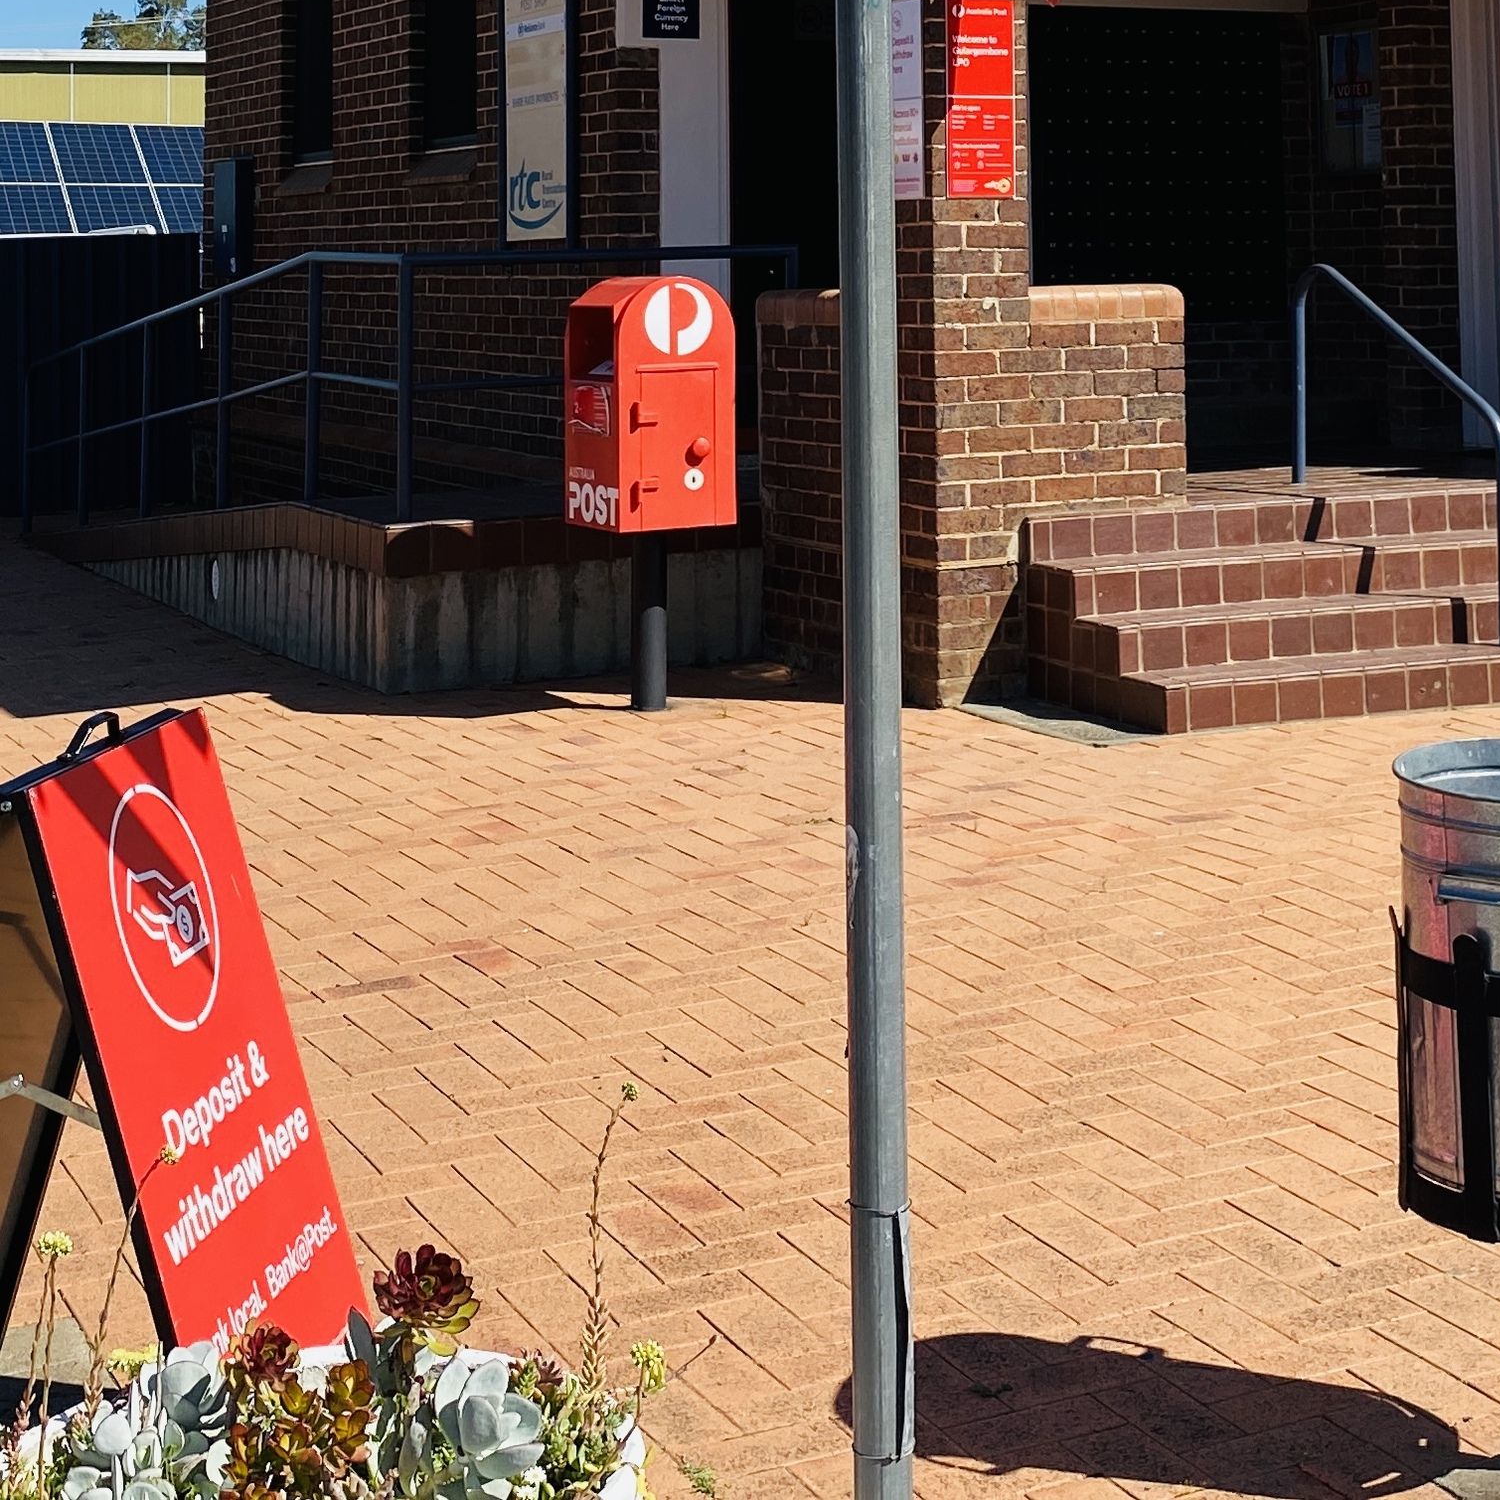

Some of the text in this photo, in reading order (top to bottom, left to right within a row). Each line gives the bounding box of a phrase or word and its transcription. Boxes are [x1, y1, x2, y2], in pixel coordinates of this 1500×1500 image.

[655, 13, 689, 23] Currency
[1337, 83, 1361, 97] VOTE
[510, 156, 541, 211] rtc
[569, 481, 619, 526] POST
[162, 1040, 270, 1158] Deposit &
[163, 1106, 310, 1267] withdraw here
